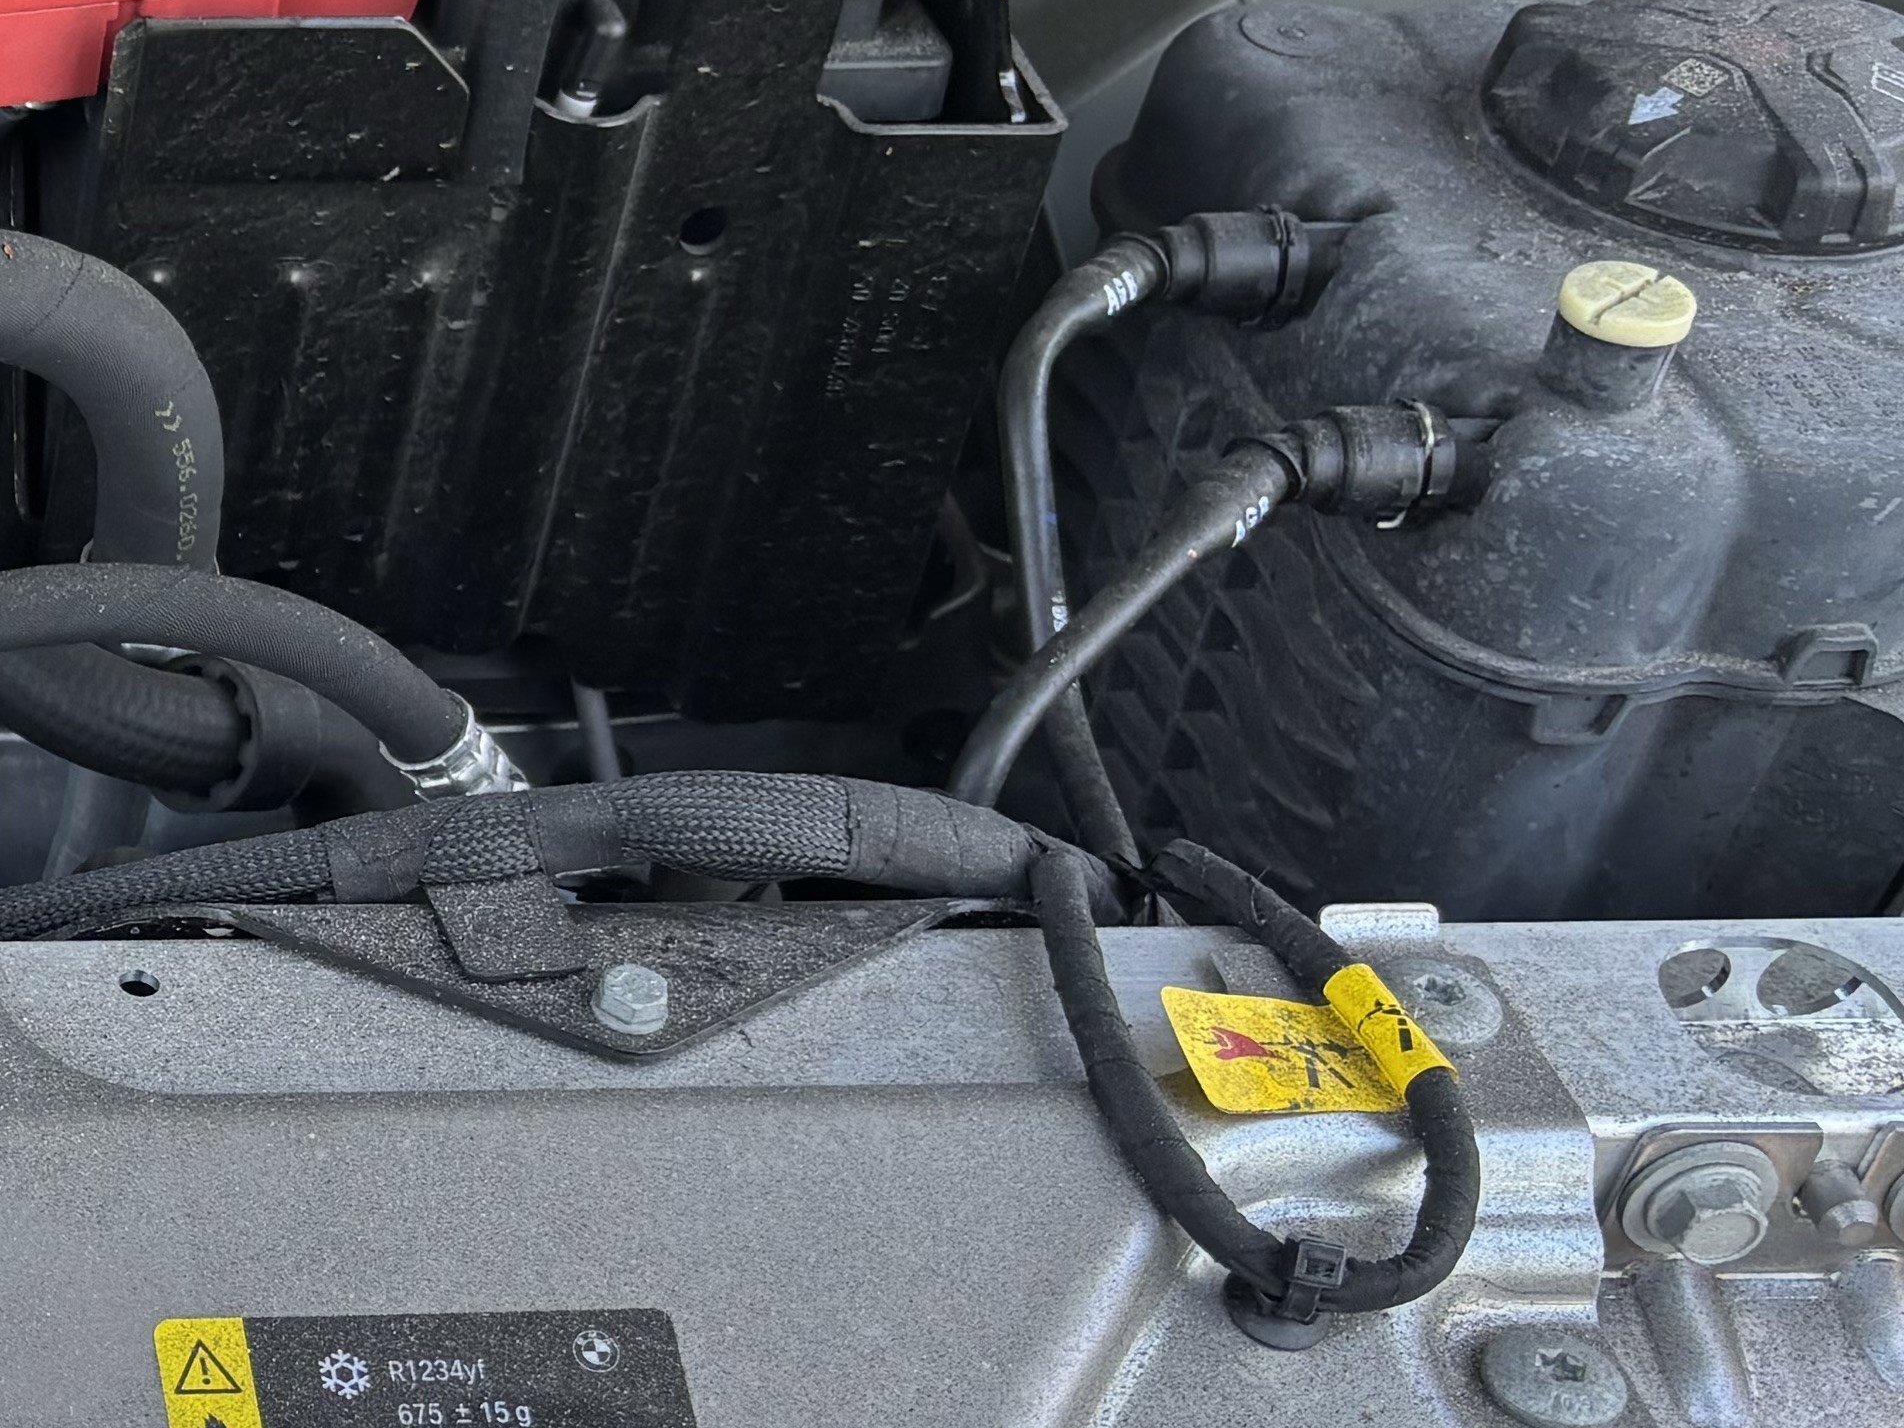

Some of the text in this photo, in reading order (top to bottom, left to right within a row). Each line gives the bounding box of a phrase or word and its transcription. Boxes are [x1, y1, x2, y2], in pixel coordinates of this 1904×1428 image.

[388, 1358, 486, 1385] R1234yf
[397, 1401, 533, 1428] 675 ± 15 g
